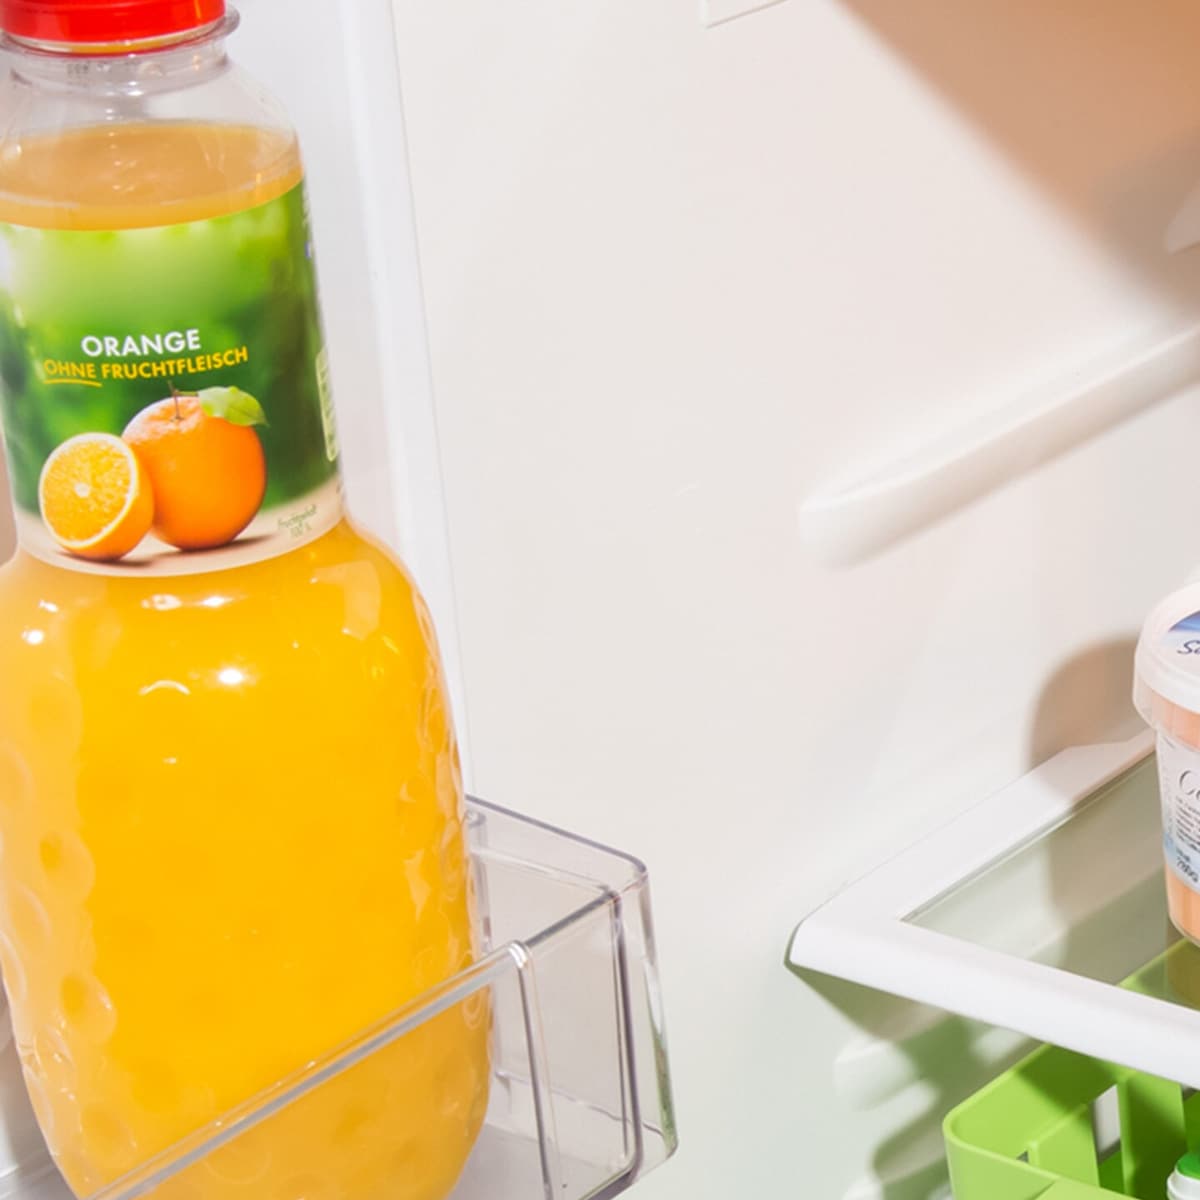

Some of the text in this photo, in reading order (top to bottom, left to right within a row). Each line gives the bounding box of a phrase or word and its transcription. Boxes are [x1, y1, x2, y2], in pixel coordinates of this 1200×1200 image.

[81, 329, 201, 358] ORANGE
[44, 346, 249, 381] OHNE FRUCHTFLEISCH
